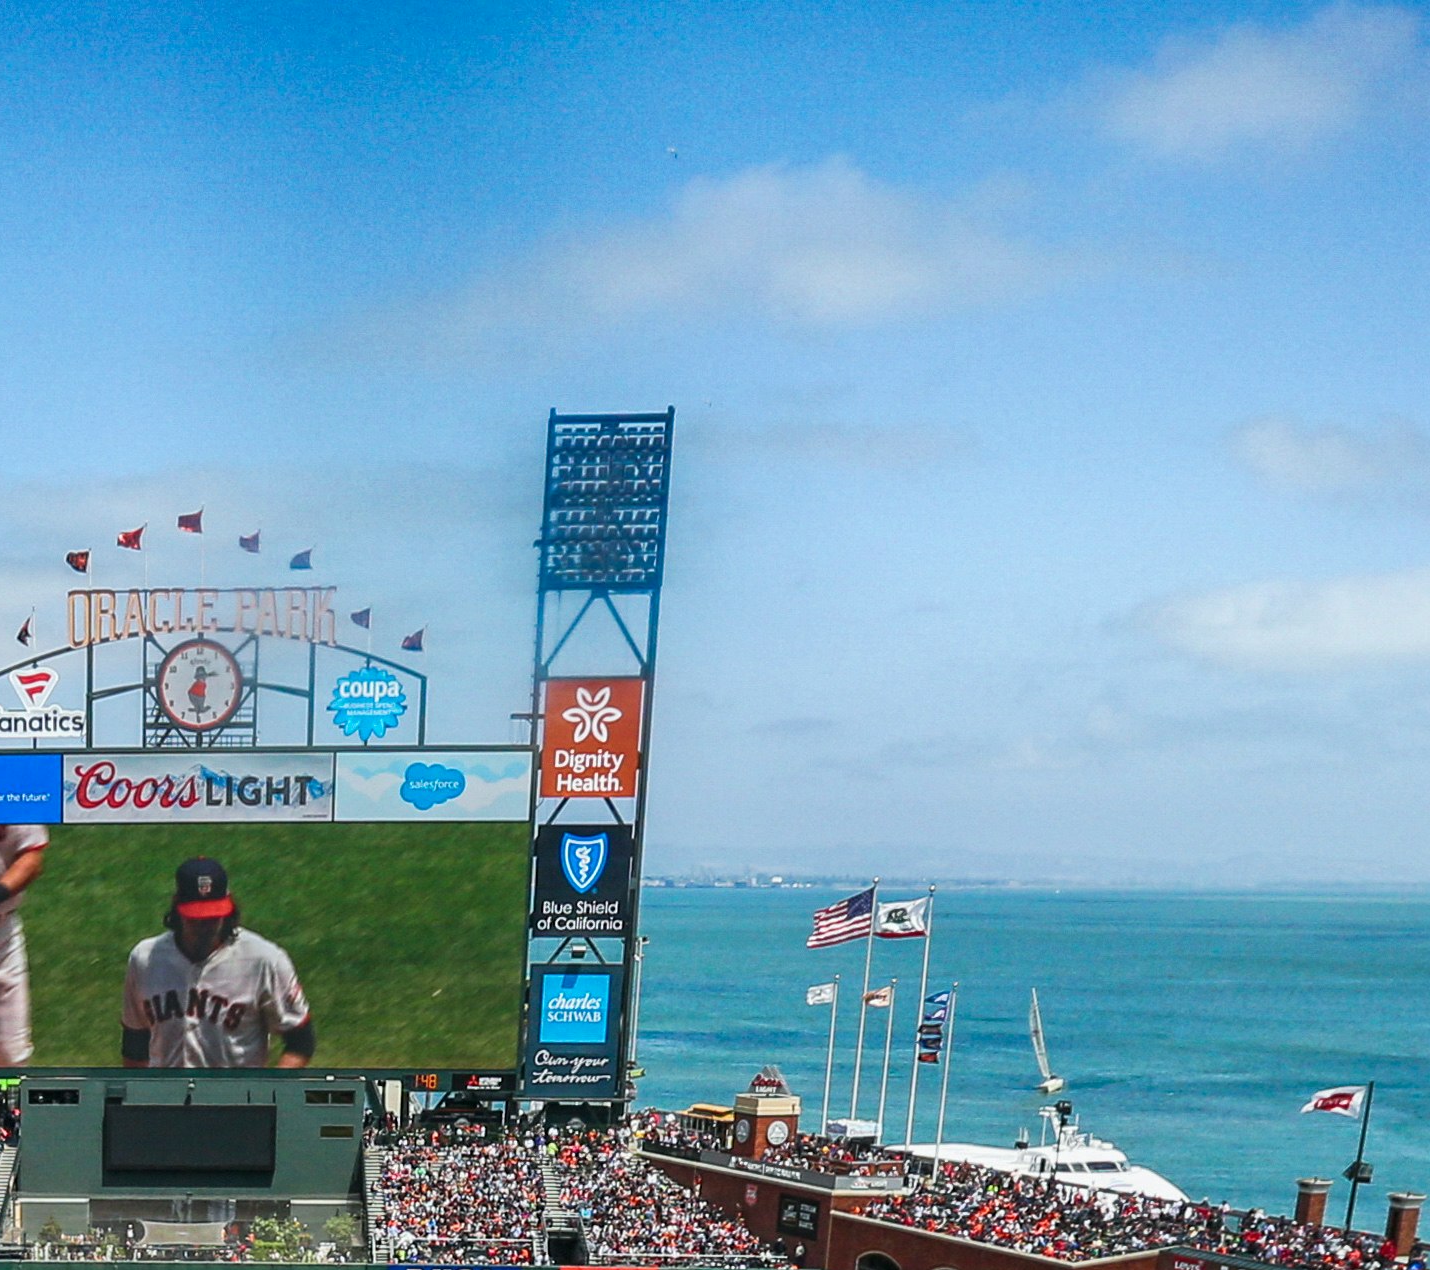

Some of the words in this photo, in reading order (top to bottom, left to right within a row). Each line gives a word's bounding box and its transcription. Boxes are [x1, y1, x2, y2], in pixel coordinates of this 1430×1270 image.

[67, 589, 220, 648] ORACLE
[236, 586, 337, 646] PARK
[339, 681, 400, 702] coupa
[555, 749, 624, 773] Dignity
[75, 761, 201, 809] Coors
[207, 774, 313, 807] LIGHT
[409, 778, 460, 793] salesforce
[7, 792, 20, 802] the
[543, 901, 572, 914] Blue
[576, 900, 619, 914] Shield
[537, 917, 550, 930] of
[554, 917, 623, 931] California
[549, 993, 601, 1010] charles
[547, 1011, 601, 1023] SCHWAB
[535, 1050, 569, 1065] Own
[570, 1056, 608, 1073] your
[532, 1070, 610, 1084] tomorrow
